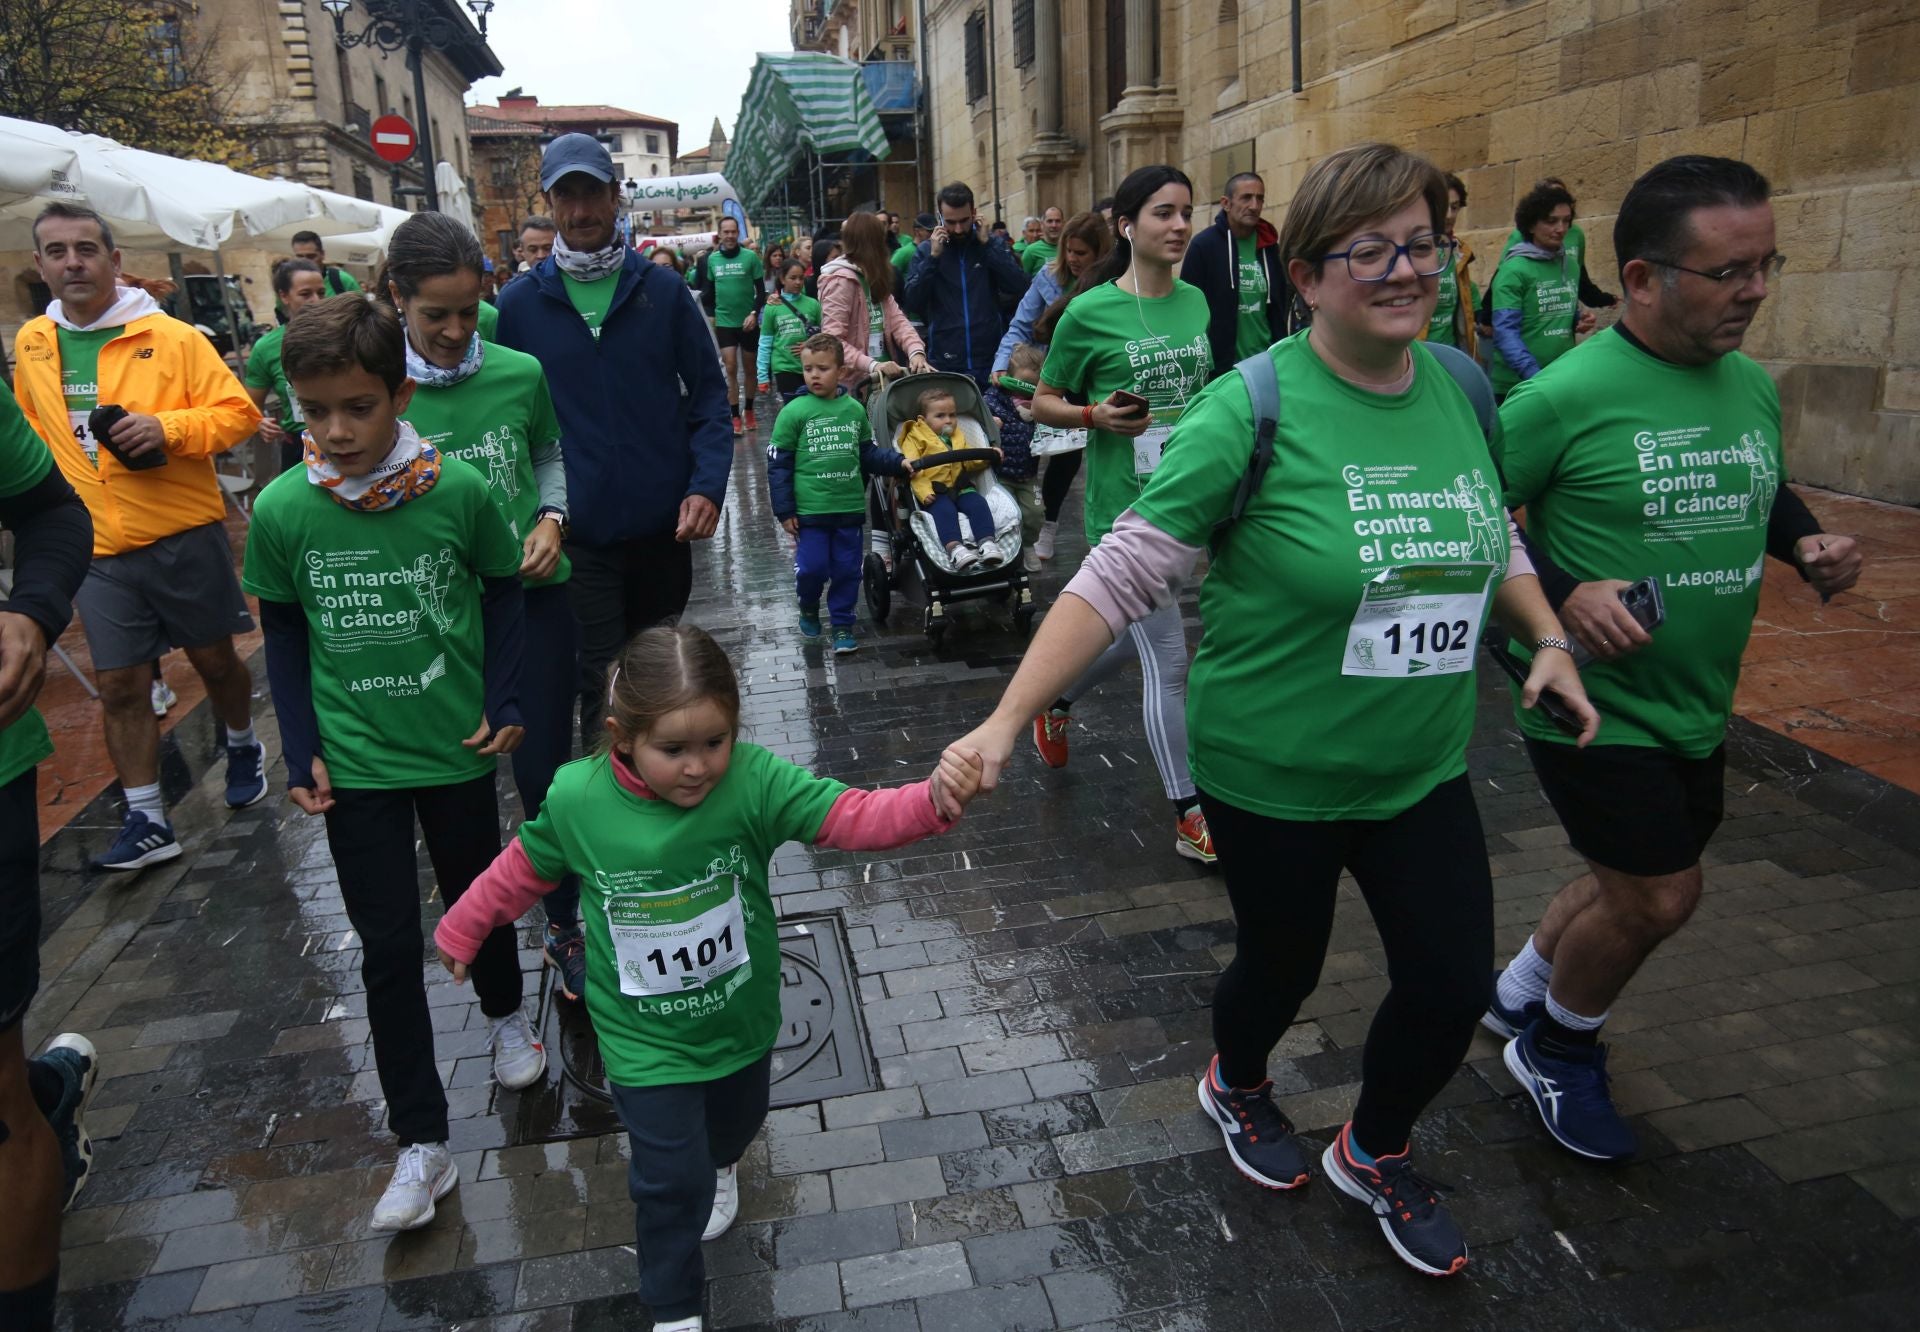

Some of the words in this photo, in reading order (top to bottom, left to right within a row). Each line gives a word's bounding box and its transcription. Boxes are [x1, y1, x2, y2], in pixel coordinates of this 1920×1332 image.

[645, 185, 675, 199] Corte
[676, 180, 719, 202] Inglés
[663, 236, 706, 246] LABORAL
[1128, 353, 1151, 368] En
[1154, 344, 1203, 362] marcha
[1133, 363, 1175, 381] contra
[1133, 382, 1145, 393] el
[1148, 375, 1193, 390] cáncer
[806, 428, 820, 437] En
[807, 434, 839, 444] contra
[808, 444, 817, 452] el
[820, 442, 853, 451] cáncer
[1637, 452, 1673, 473] En
[1680, 445, 1755, 468] marcha
[1641, 470, 1717, 494] contra
[1347, 488, 1381, 511] En
[1387, 487, 1471, 509] marcha
[1643, 496, 1666, 517] el
[1674, 492, 1750, 514] cáncer
[1353, 513, 1432, 536] contra
[1359, 539, 1382, 562] el
[1390, 537, 1469, 560] cáncer
[309, 569, 337, 589] En
[343, 566, 426, 587] marcha
[1444, 568, 1472, 577] contra
[1666, 568, 1743, 587] LABORAL
[315, 589, 383, 609] contra
[1370, 585, 1379, 594] el
[1714, 584, 1743, 595] kutxa
[321, 611, 335, 629] el
[340, 608, 419, 629] cáncer
[1384, 619, 1469, 655] 1102
[342, 674, 418, 692] LABORAL
[387, 687, 420, 697] kutxa
[609, 899, 640, 909] Oviedo
[640, 901, 652, 909] en
[653, 895, 690, 909] marcha
[690, 883, 720, 899] contra
[622, 910, 651, 919] cáncer
[646, 925, 733, 976] 1101
[637, 989, 723, 1016] LABORAL
[690, 1000, 726, 1019] kutxa
